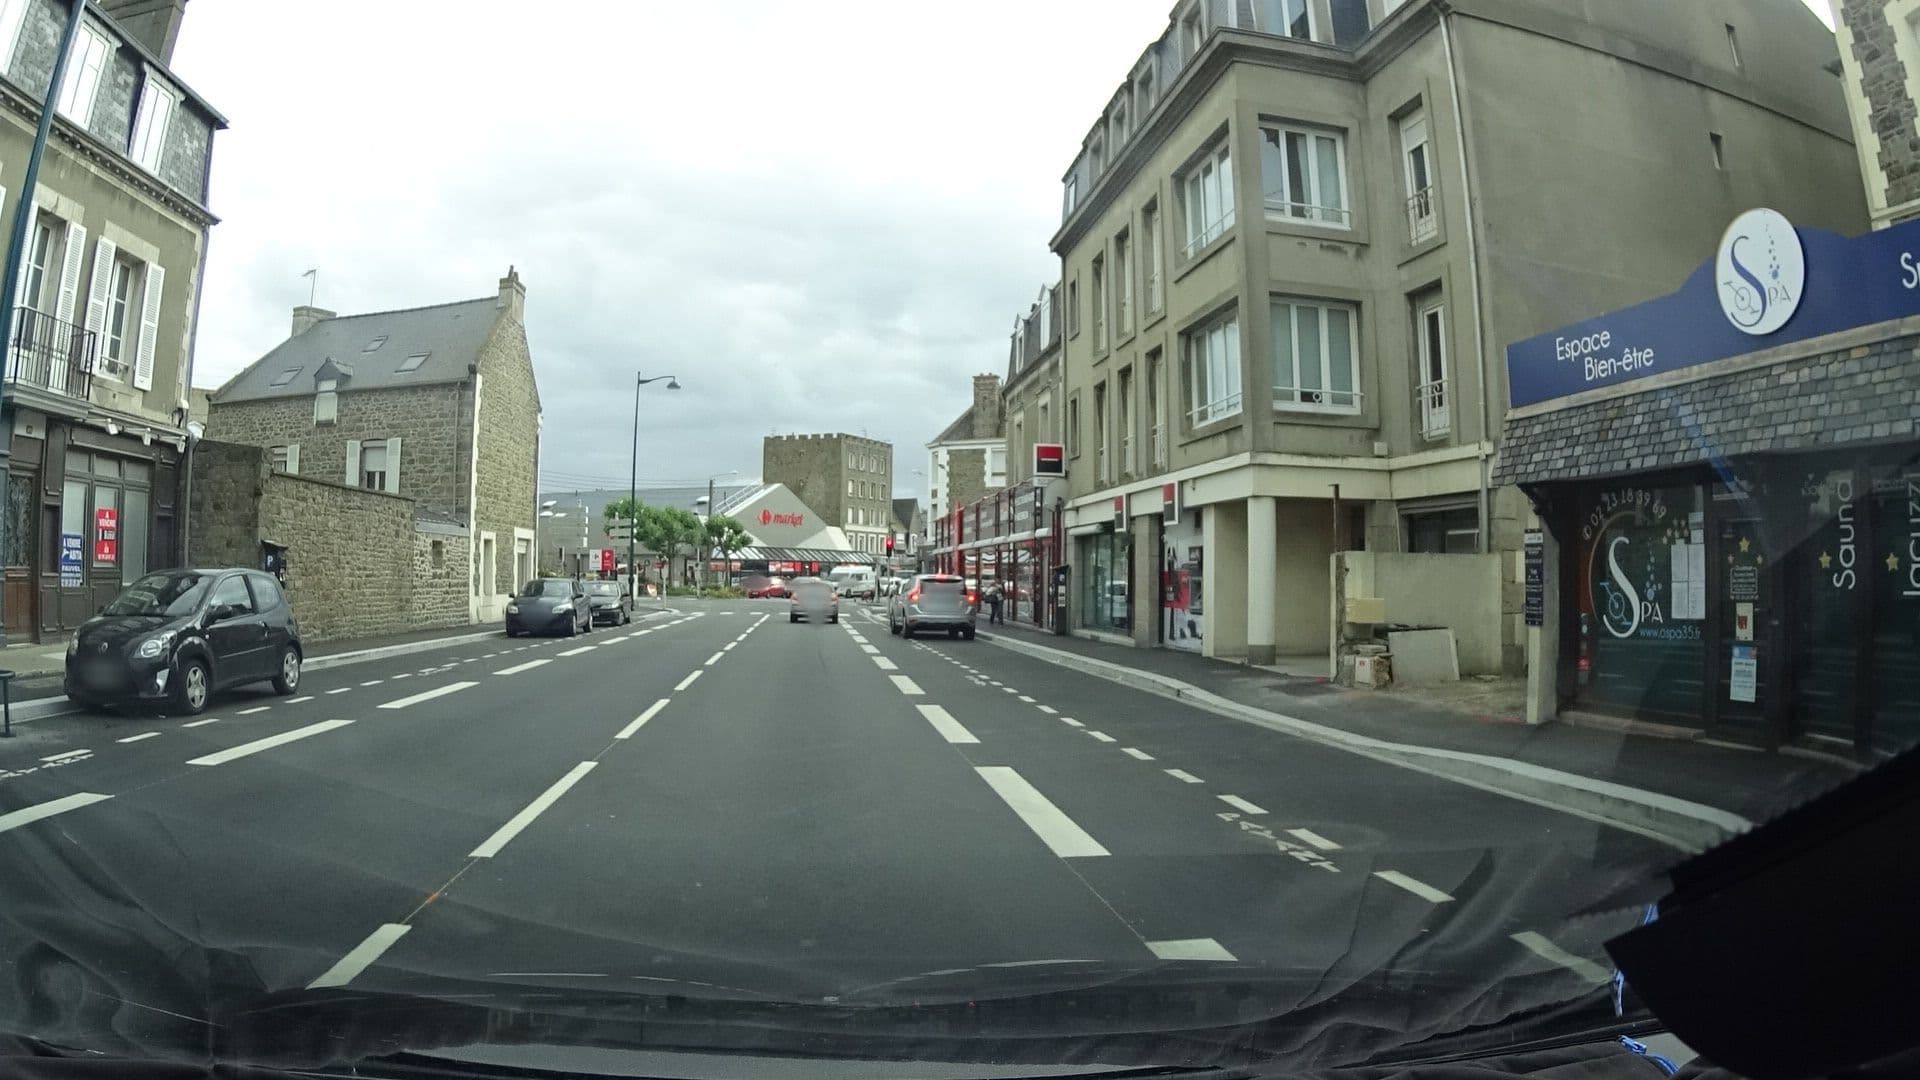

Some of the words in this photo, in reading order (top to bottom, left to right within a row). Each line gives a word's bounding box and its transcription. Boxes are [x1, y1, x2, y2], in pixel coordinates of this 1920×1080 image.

[1555, 330, 1611, 362] Espace
[1584, 346, 1655, 382] Bien-être
[1652, 502, 1667, 519] 69
[1832, 479, 1856, 590] Sauna
[267, 555, 274, 567] P
[1215, 812, 1342, 873] PAYANT
